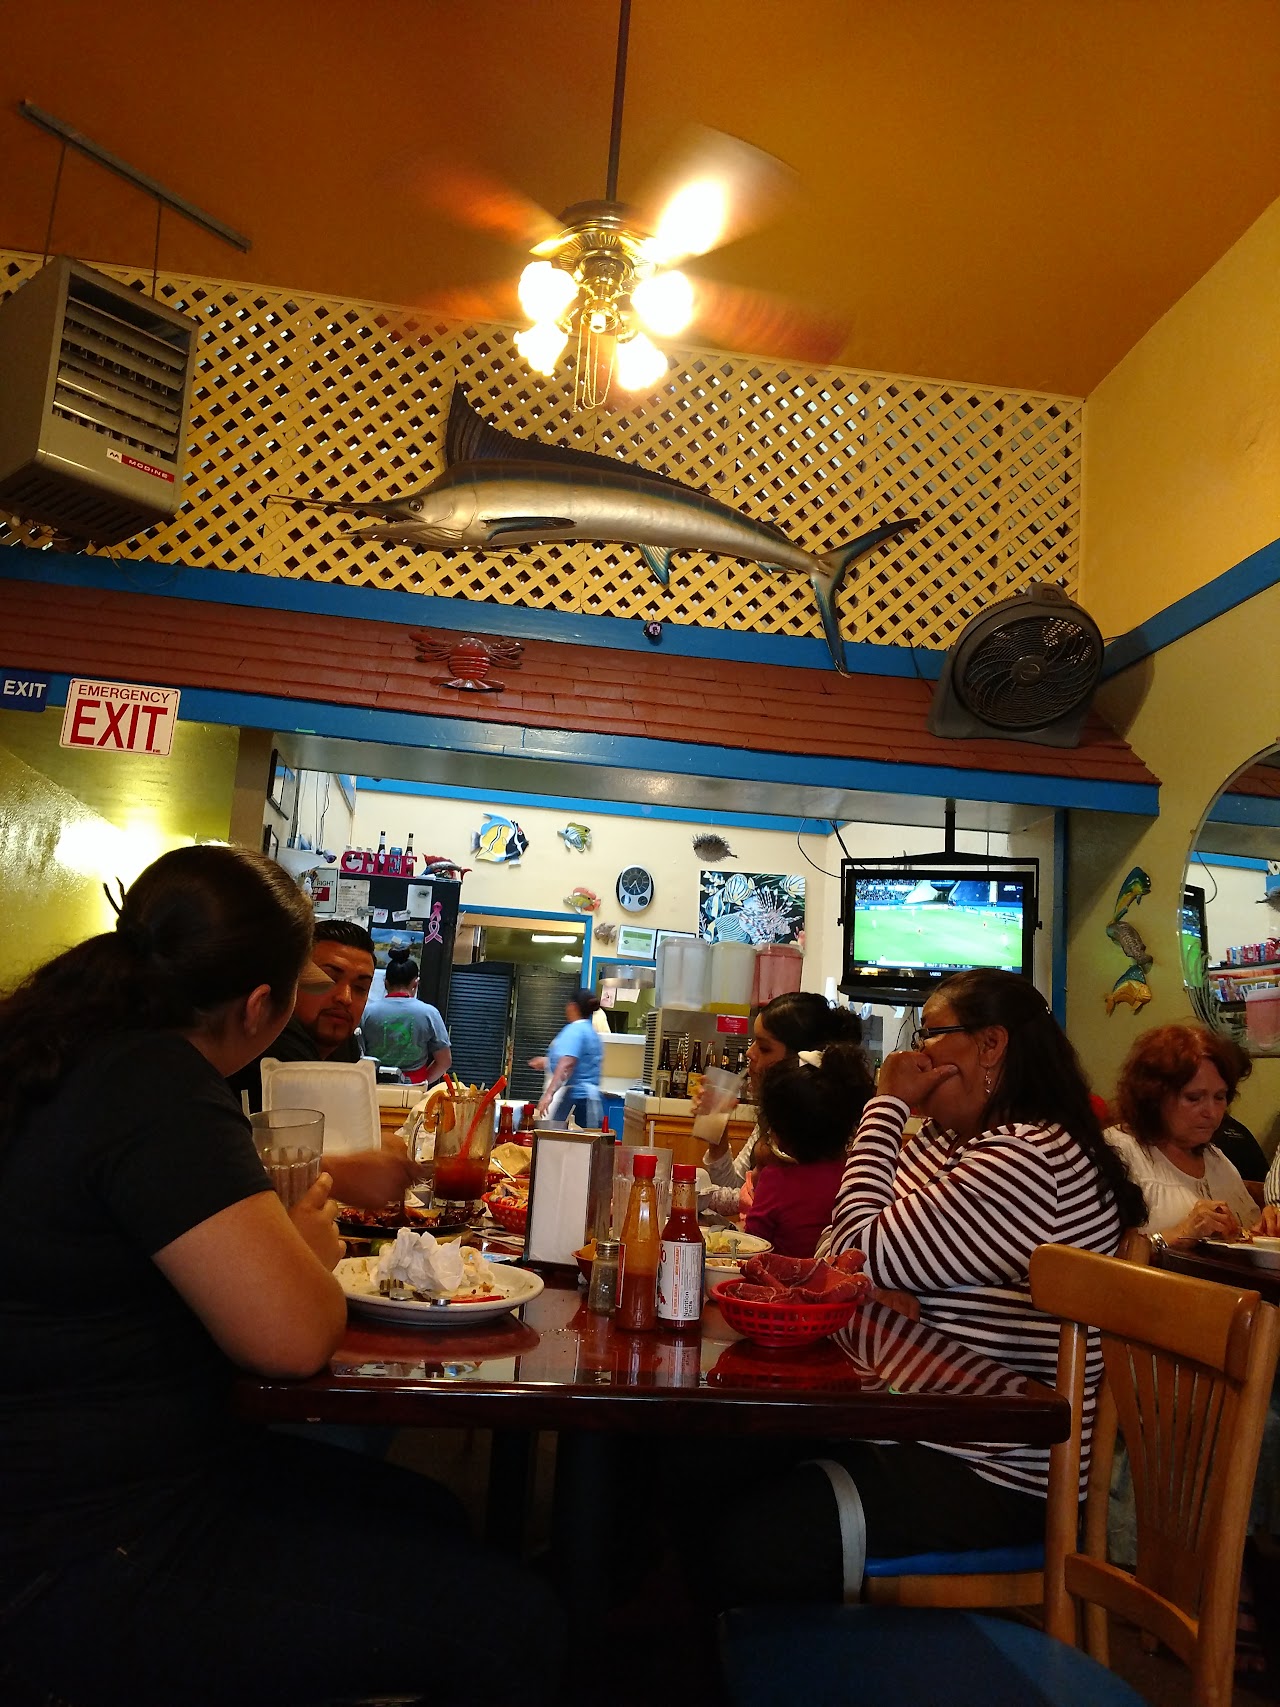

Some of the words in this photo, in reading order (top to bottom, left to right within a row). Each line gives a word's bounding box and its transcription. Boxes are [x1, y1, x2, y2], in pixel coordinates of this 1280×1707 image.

[128, 459, 168, 479] MODINE
[3, 679, 47, 699] EXIT
[78, 684, 170, 704] EMERGENCY
[70, 698, 169, 751] EXIT
[340, 851, 418, 878] CHEF
